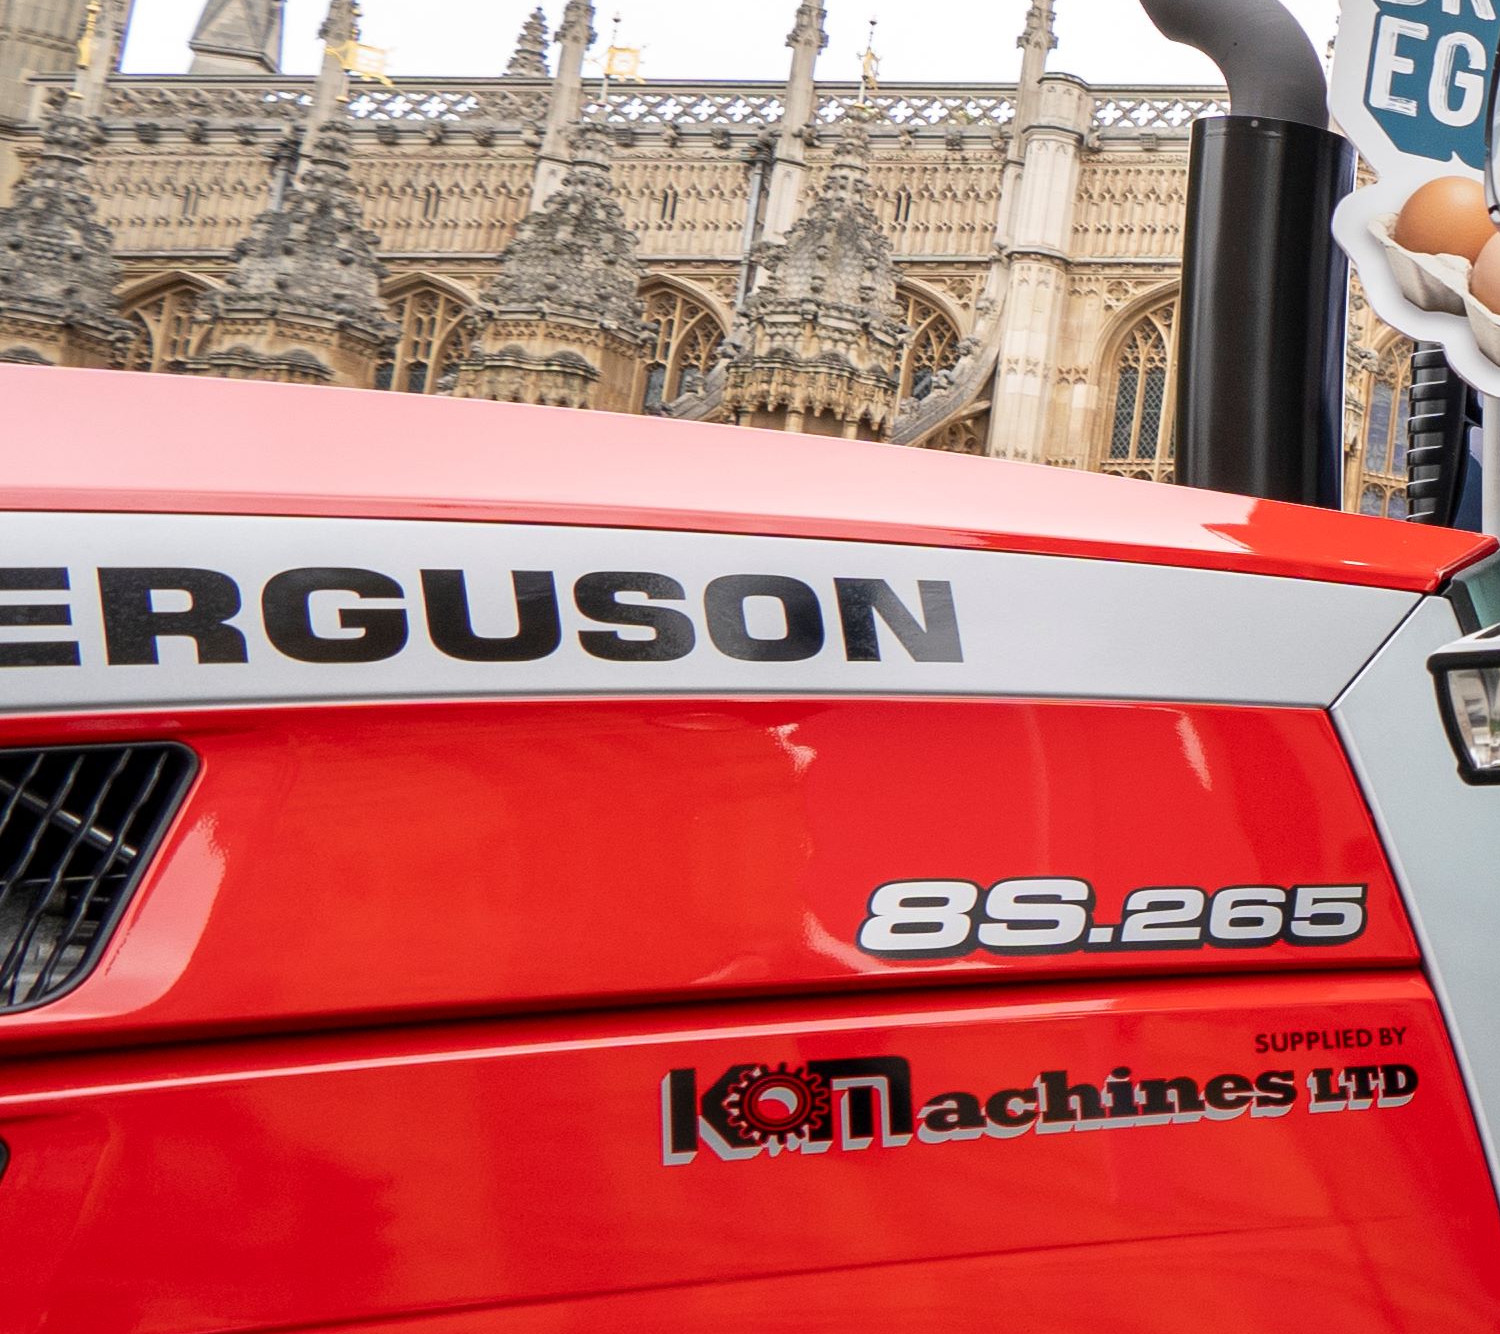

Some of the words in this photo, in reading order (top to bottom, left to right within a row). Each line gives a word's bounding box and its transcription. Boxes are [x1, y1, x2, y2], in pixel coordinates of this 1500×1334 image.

[1368, 14, 1487, 128] EG
[0, 565, 964, 666] ERGUSON
[860, 877, 1368, 955] 8S.265
[1255, 1029, 1374, 1054] SUPPLIED
[1381, 1026, 1407, 1048] BY
[1306, 1063, 1420, 1112] LTD
